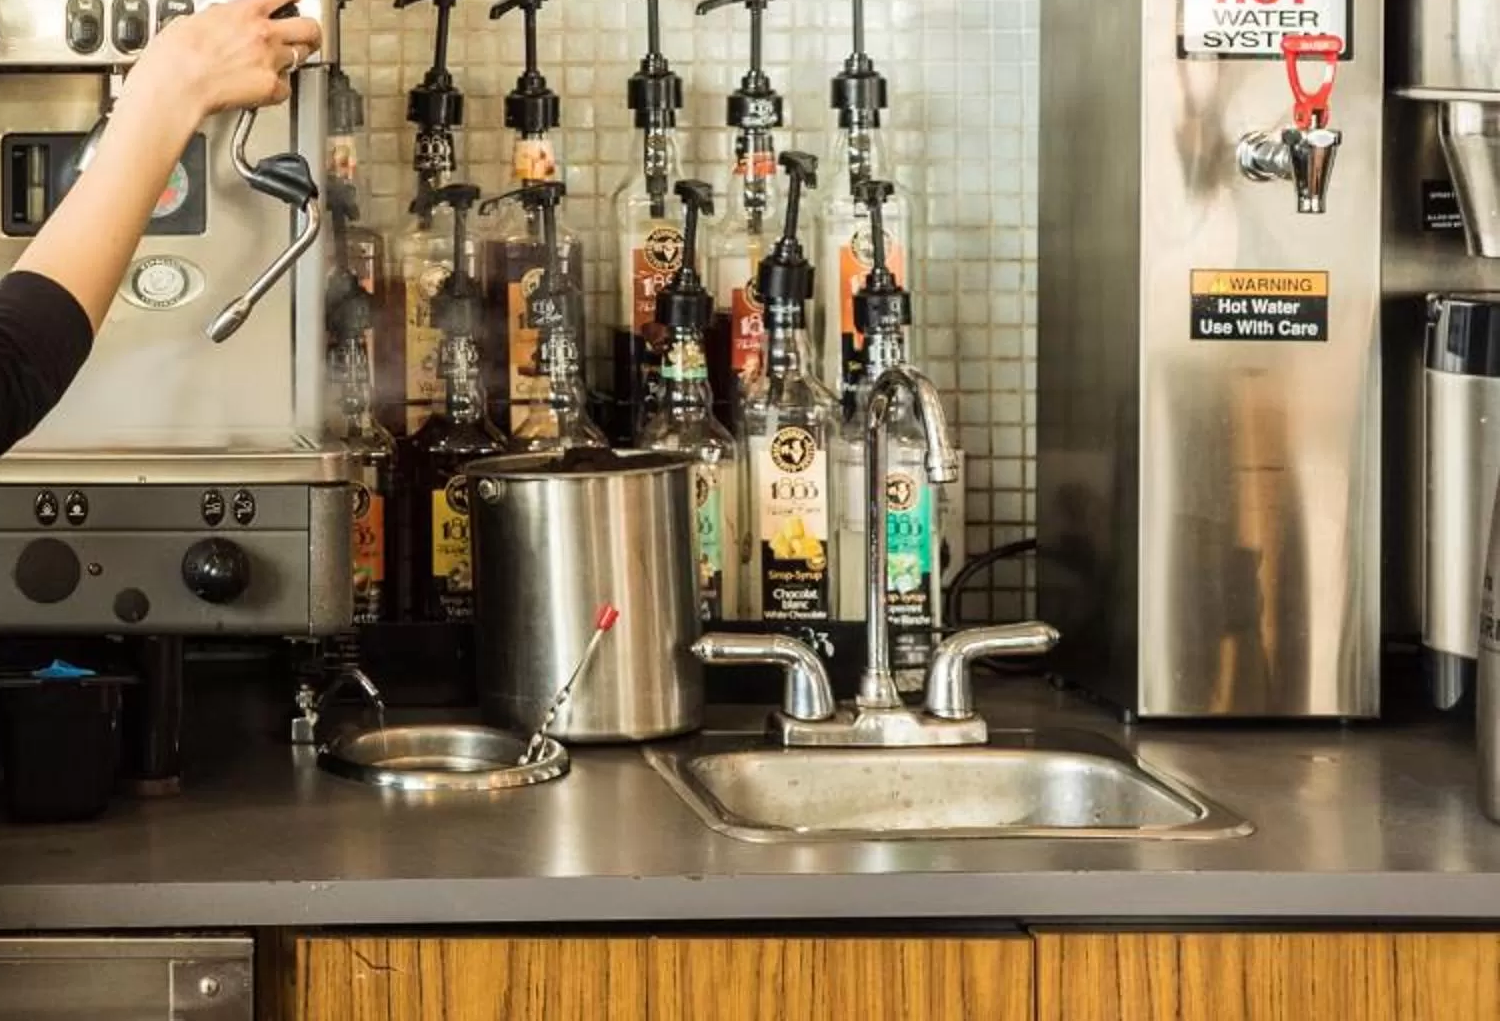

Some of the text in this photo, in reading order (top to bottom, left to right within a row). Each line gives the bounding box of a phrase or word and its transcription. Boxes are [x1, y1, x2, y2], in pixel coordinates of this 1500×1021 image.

[1212, 10, 1318, 27] WATER
[1203, 31, 1327, 49] SYST
[1230, 279, 1312, 291] WARNING
[1218, 299, 1300, 314] Hot Water
[1200, 319, 1318, 335] Use With Care
